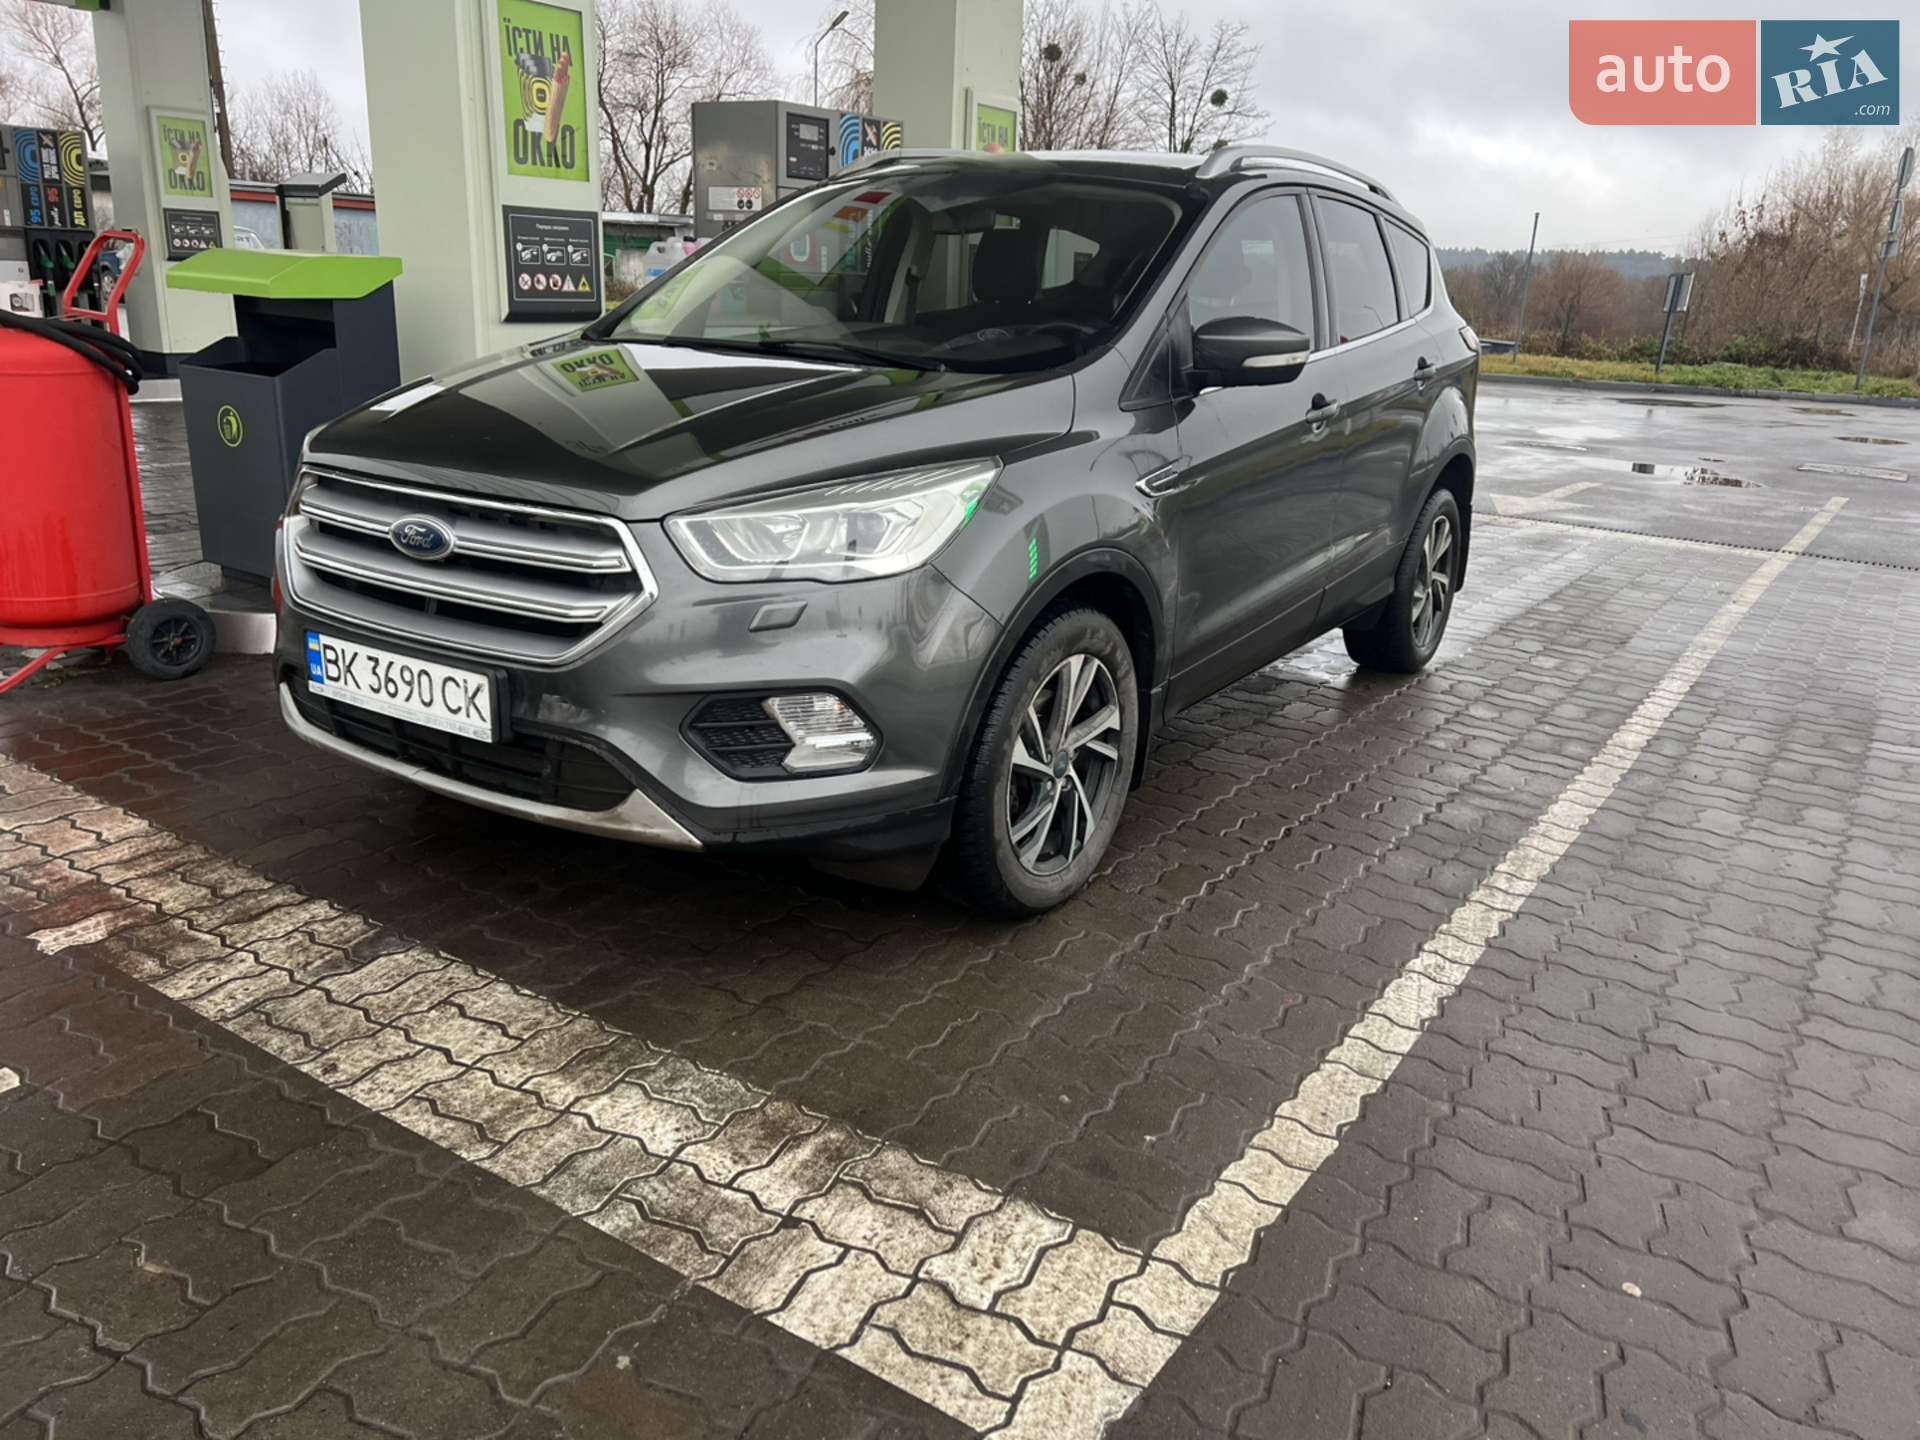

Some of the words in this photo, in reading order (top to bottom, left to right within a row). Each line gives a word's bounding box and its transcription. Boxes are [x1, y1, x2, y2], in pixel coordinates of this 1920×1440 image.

[503, 17, 545, 57] ЇСТИ
[549, 33, 573, 67] НА
[163, 124, 187, 143] ЇСТИ
[513, 118, 576, 170] ОККО
[168, 168, 206, 192] ОККО
[47, 188, 59, 203] 95
[29, 208, 42, 225] 95
[73, 211, 86, 227] ДП
[398, 524, 434, 548] Ford
[310, 662, 323, 677] UA
[323, 643, 362, 691] BK
[366, 655, 434, 709] 3690
[442, 675, 488, 723] CK
